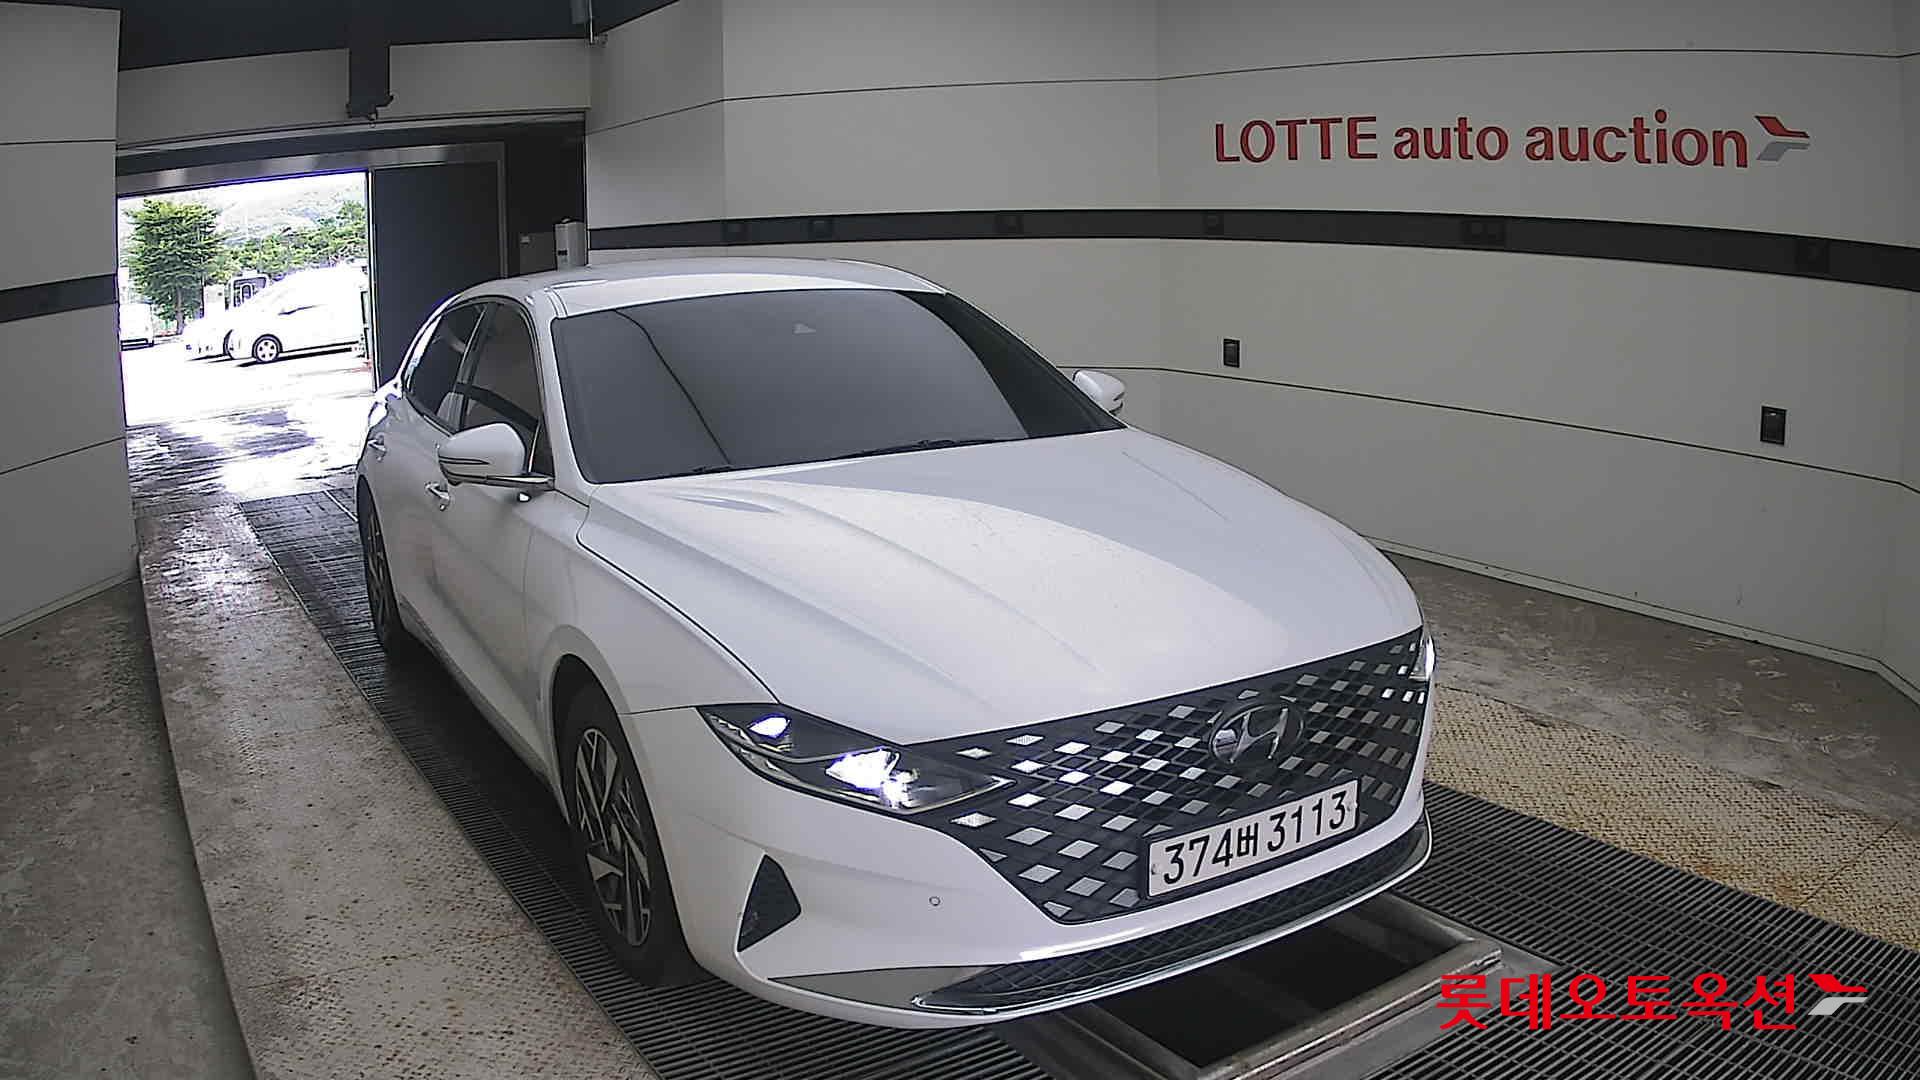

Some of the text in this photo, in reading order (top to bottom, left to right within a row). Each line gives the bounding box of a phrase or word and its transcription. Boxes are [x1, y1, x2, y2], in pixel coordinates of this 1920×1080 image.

[1215, 109, 1749, 168] LOTTE auto auction
[1163, 790, 1347, 885] 374버 3113
